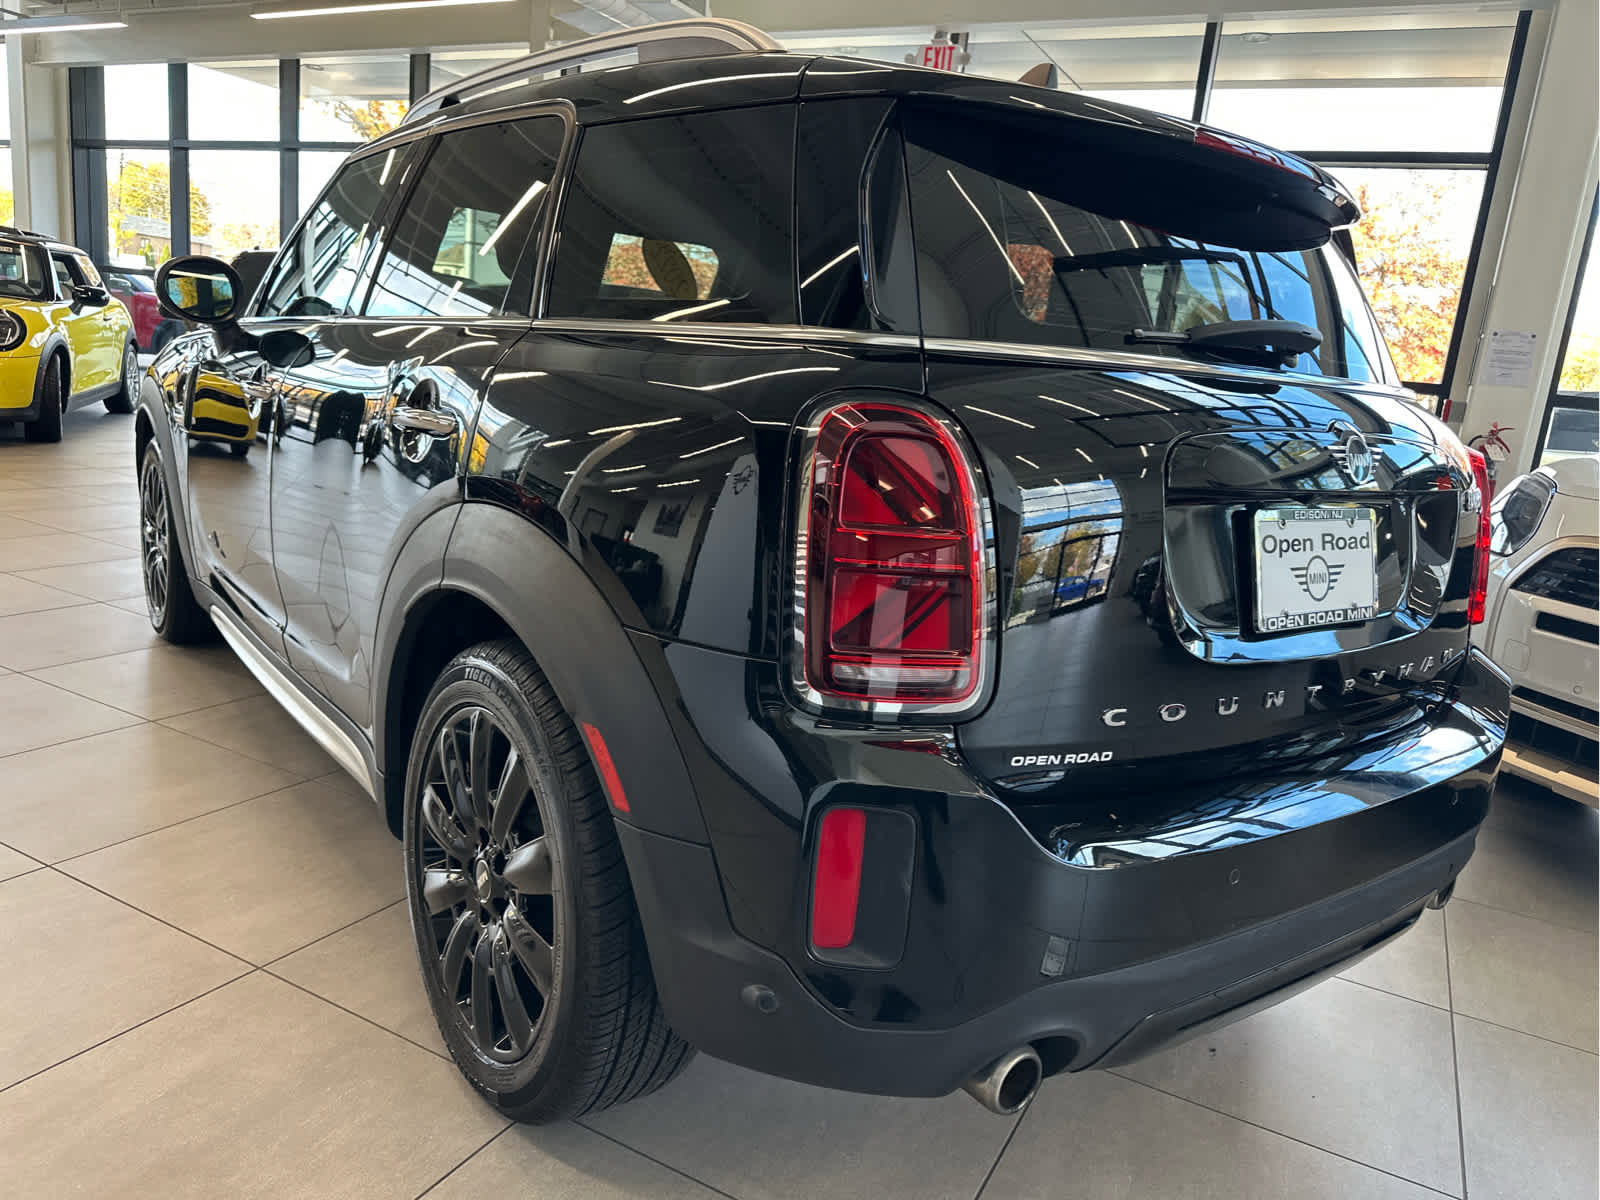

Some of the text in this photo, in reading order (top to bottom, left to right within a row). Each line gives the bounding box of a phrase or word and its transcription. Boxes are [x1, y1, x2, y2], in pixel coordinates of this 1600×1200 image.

[923, 46, 955, 71] EXIT
[1331, 510, 1344, 519] NJ
[1262, 531, 1370, 558] Open Road
[1309, 573, 1327, 584] MINI
[1267, 606, 1373, 630] OPEN ROAD MINI
[464, 667, 493, 687] TIGER
[1010, 751, 1113, 767] OPEN ROAD
